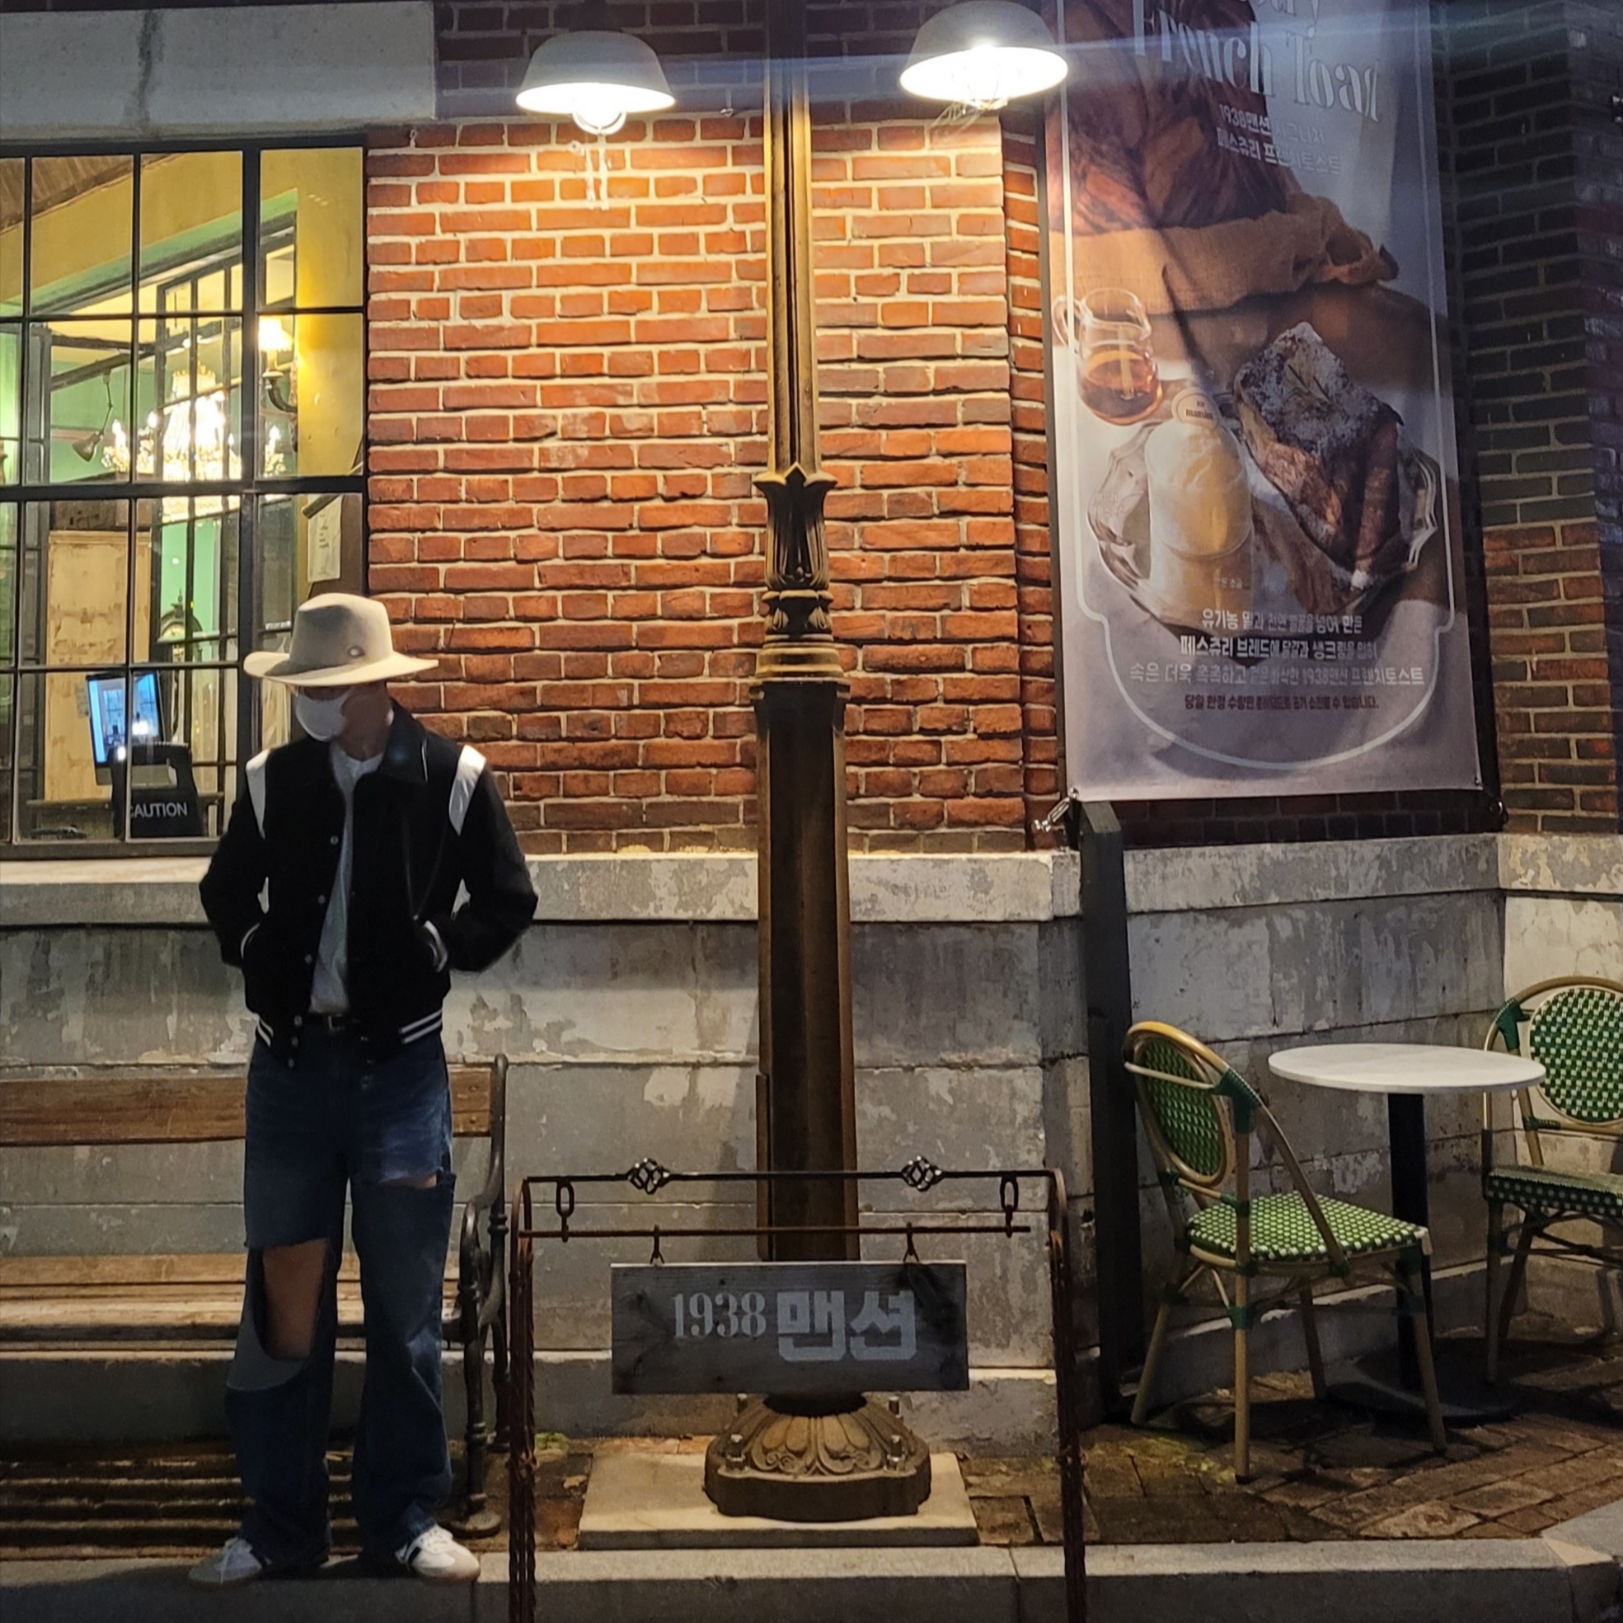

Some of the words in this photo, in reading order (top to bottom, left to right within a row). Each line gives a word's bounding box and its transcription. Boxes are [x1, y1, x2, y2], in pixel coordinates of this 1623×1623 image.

[1201, 607, 1239, 631] 유기농
[1179, 634, 1233, 658] 페스츄리
[1129, 661, 1160, 683] 속은
[1164, 662, 1192, 684] 더욱
[1196, 663, 1247, 685] 촉촉하고
[1184, 693, 1205, 710] 당일
[672, 1290, 767, 1340] 1938
[776, 1289, 918, 1363] 맨션
